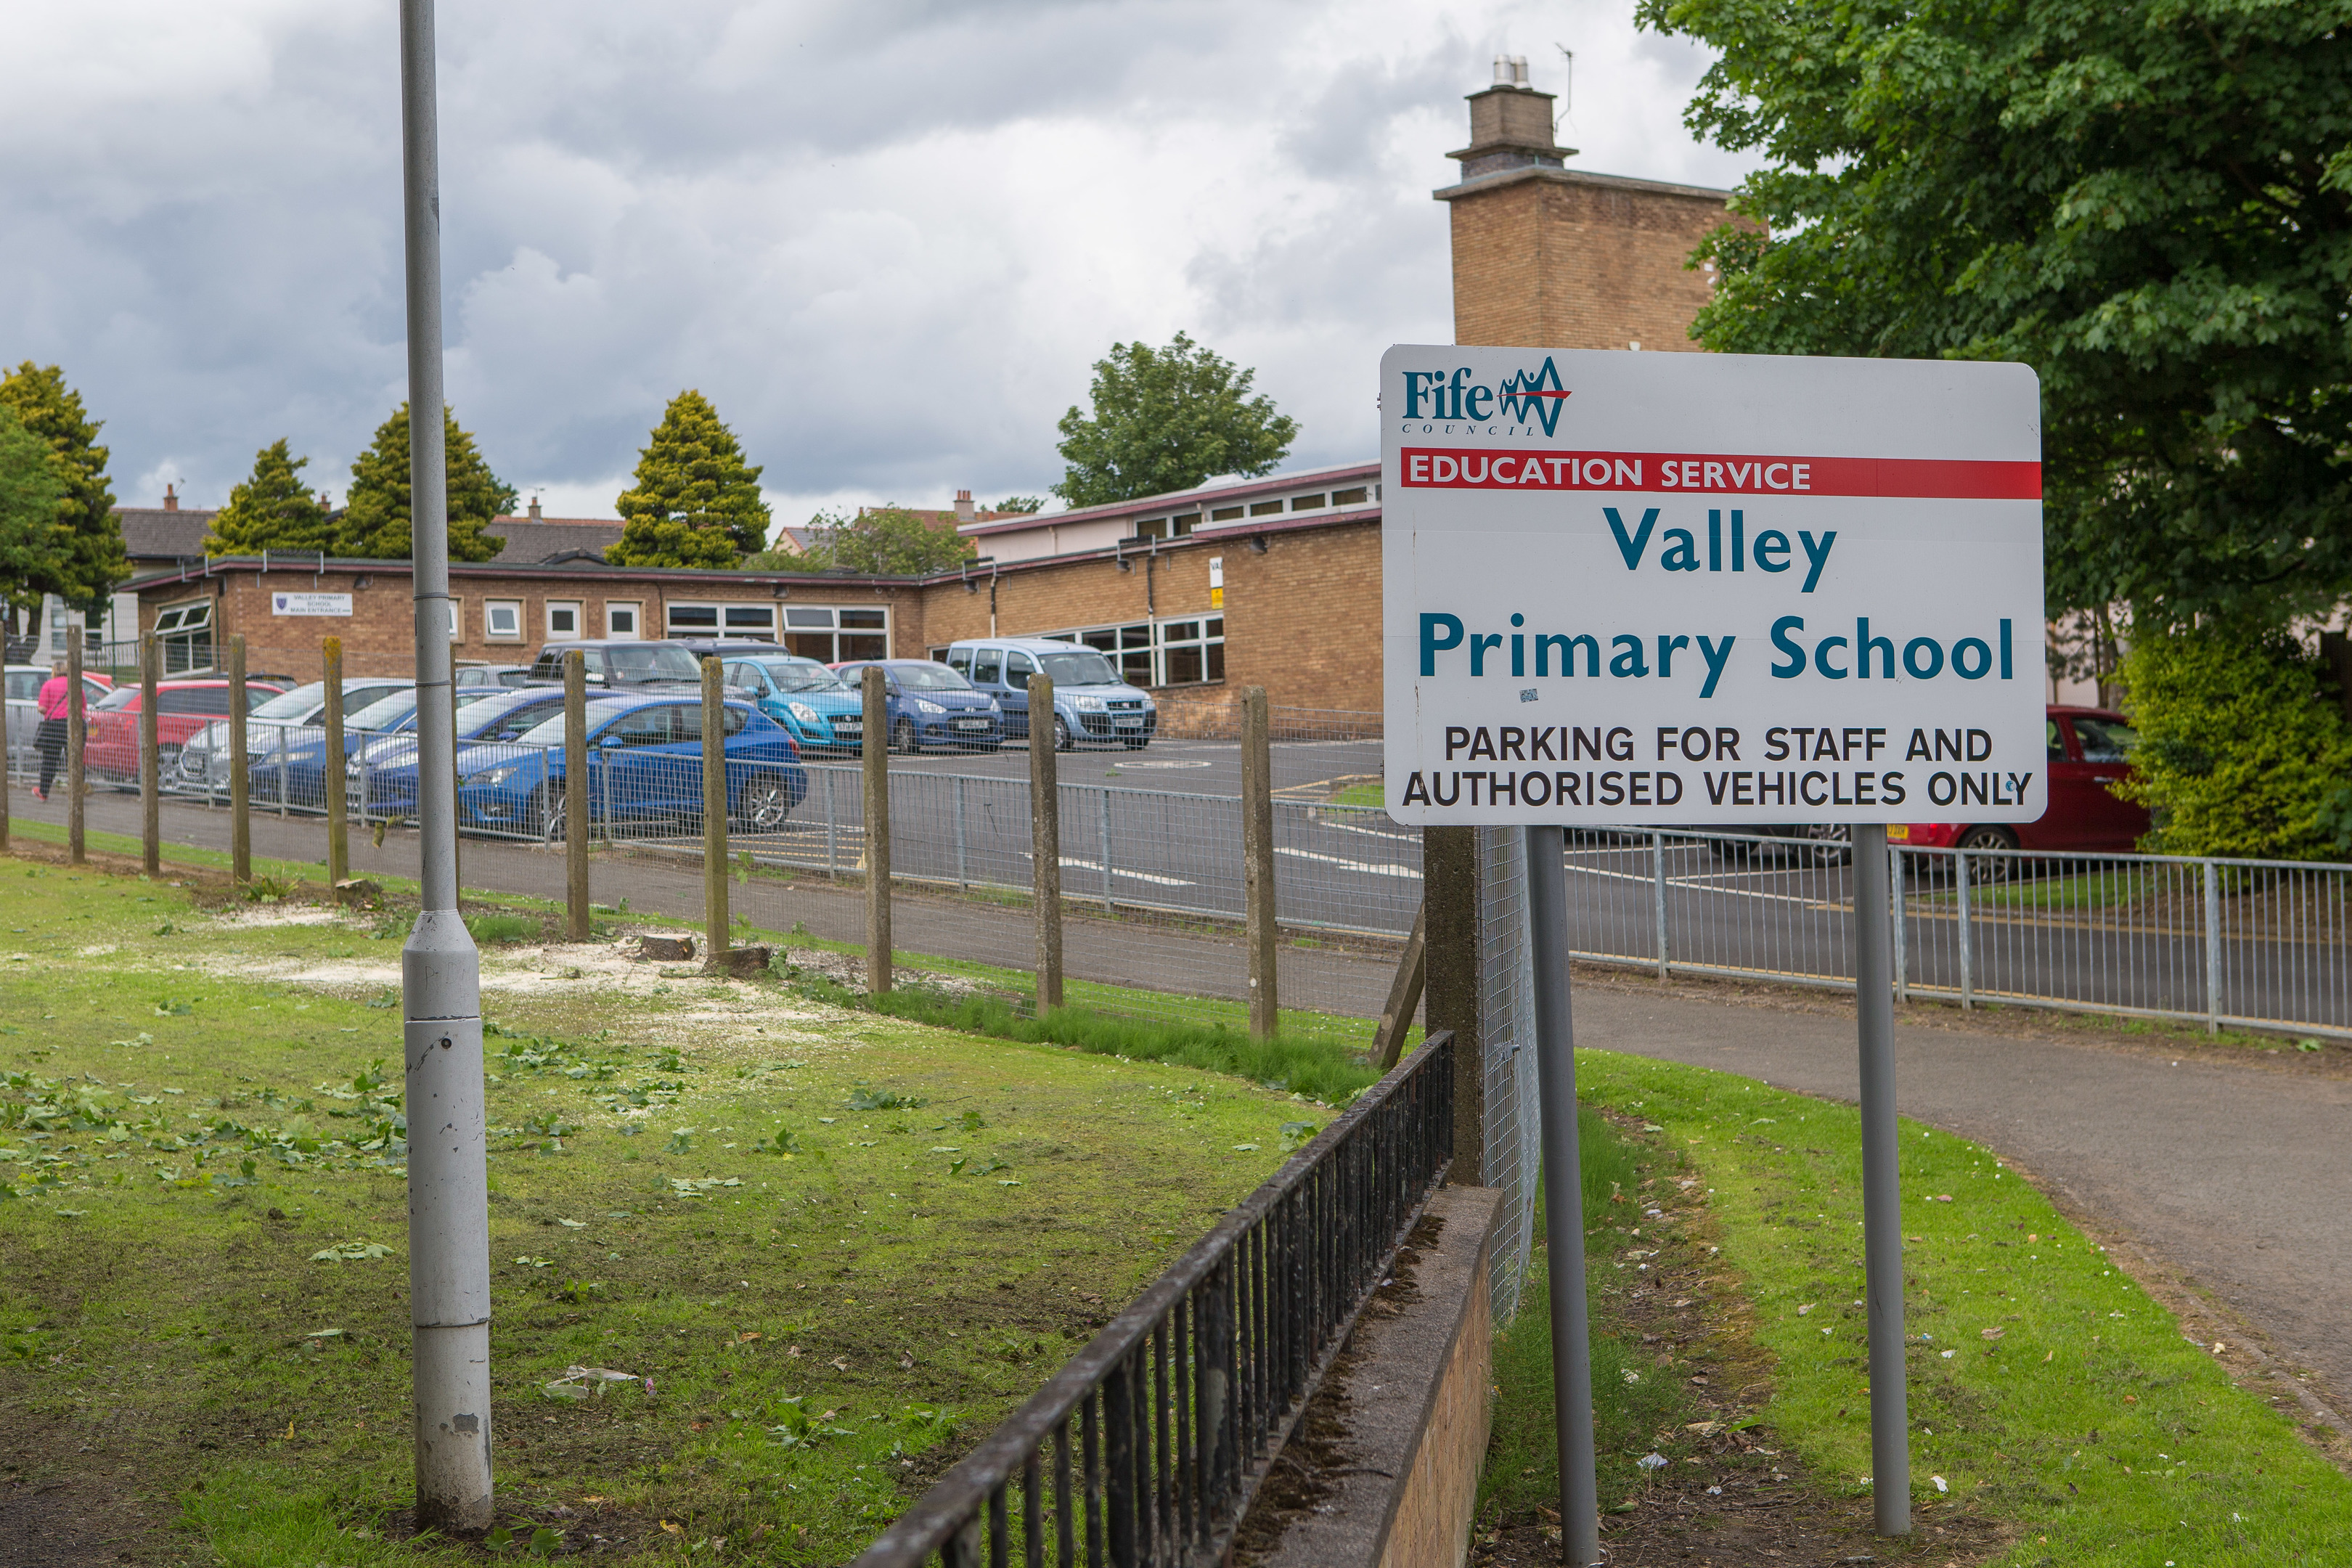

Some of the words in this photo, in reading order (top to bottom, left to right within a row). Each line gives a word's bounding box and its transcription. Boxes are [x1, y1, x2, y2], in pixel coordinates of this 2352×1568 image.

[1402, 367, 1493, 421] Fife
[1402, 424, 1534, 436] COUNCIL
[1410, 455, 1642, 486] EDUCATION
[1662, 461, 1810, 490] SERVICE
[1602, 507, 1837, 593] Valley
[1420, 613, 1736, 698] Primary
[1771, 616, 2013, 680] School
[1446, 727, 1634, 761] PARKING
[1657, 727, 1741, 761] FOR
[1764, 727, 1886, 761] STAFF
[1906, 728, 1993, 761] AND
[1402, 770, 1683, 807] AUTHORISED
[1703, 771, 1906, 806] VEHICLES
[1928, 772, 2033, 806] ONLY
